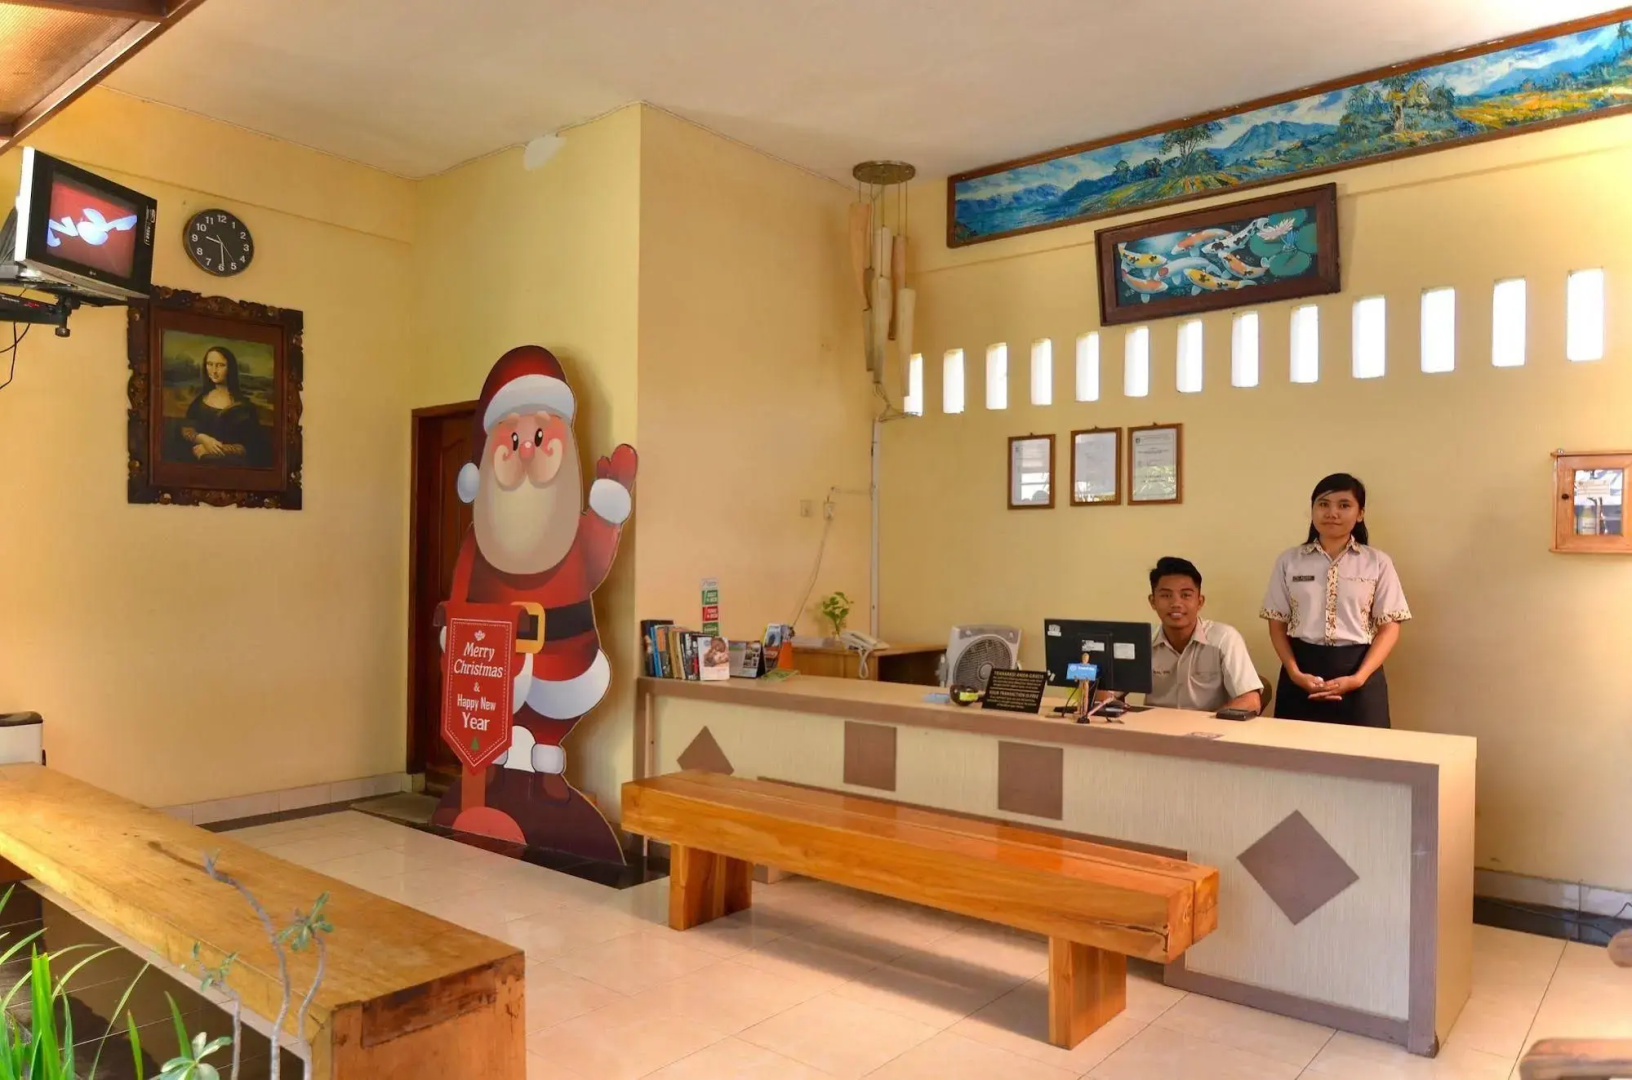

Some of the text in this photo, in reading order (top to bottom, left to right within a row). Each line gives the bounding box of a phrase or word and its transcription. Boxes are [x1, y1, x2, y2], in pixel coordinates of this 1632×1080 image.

[205, 216, 214, 224] 11
[217, 214, 227, 224] 12
[196, 223, 206, 232] 10
[192, 234, 198, 242] 9
[240, 232, 246, 240] 2
[196, 248, 203, 256] 8
[206, 258, 212, 266] 7
[240, 255, 246, 263] 4
[218, 264, 224, 272] 6
[230, 262, 236, 270] 5
[463, 642, 495, 662] Merry
[453, 658, 504, 678] Christmas
[473, 682, 480, 692] &
[457, 694, 496, 711] Happy New
[462, 712, 490, 731] Year
